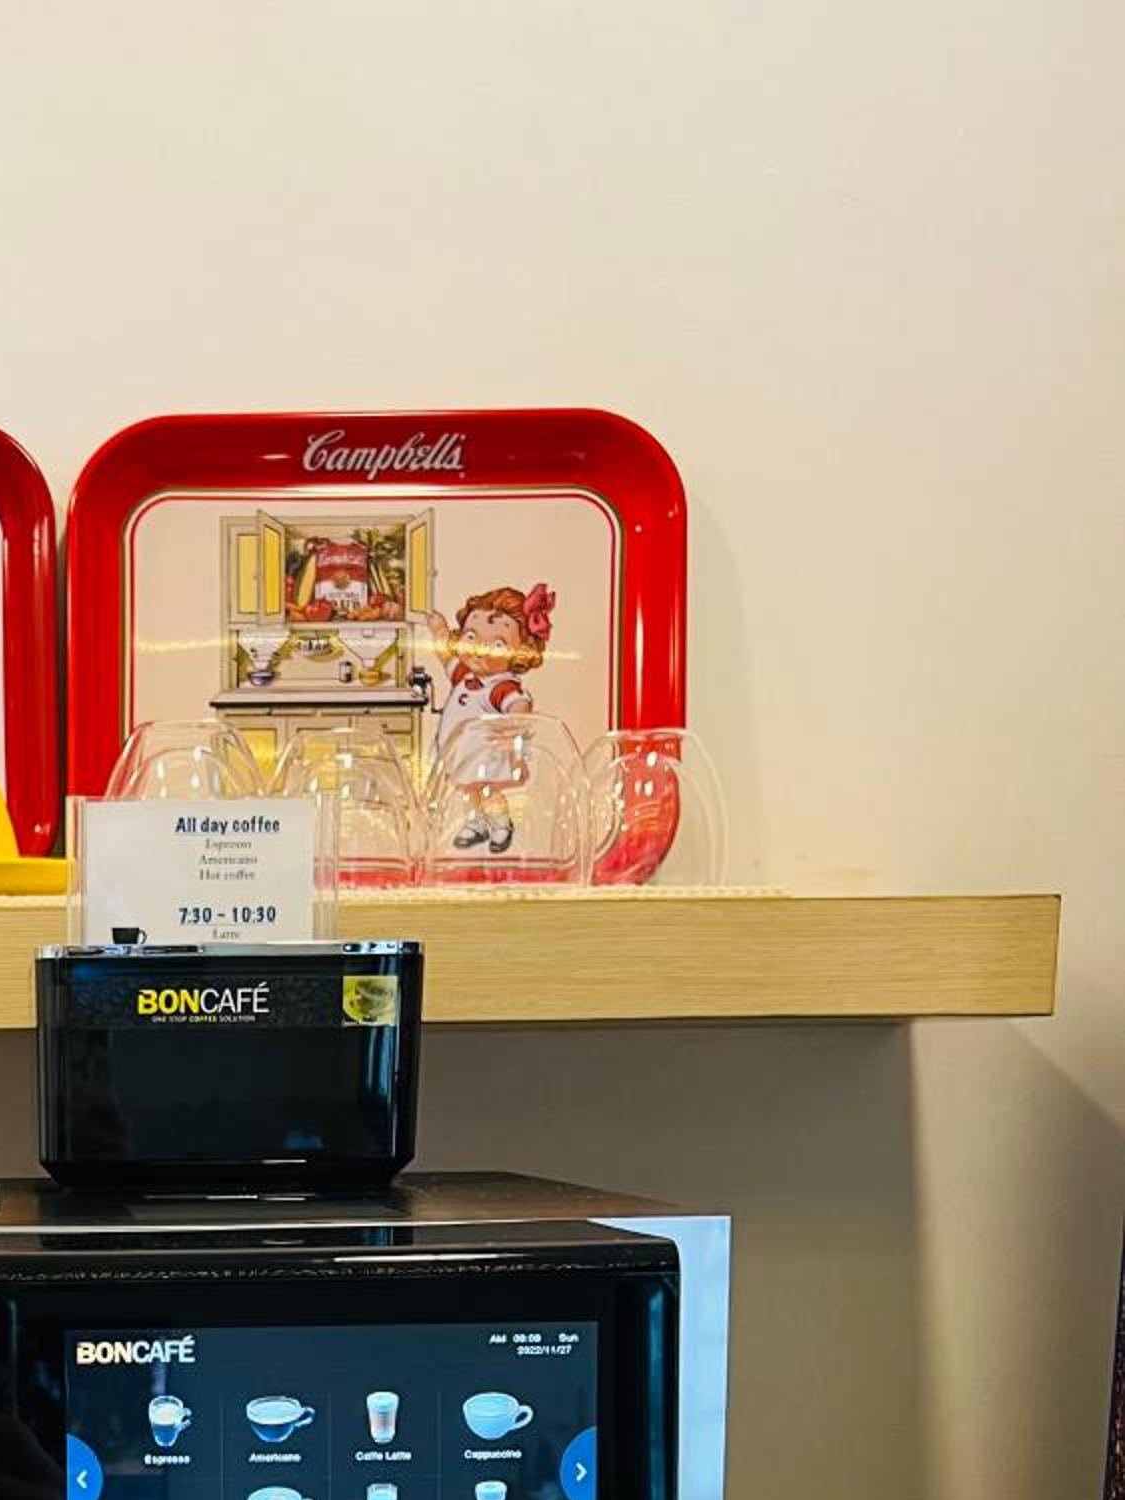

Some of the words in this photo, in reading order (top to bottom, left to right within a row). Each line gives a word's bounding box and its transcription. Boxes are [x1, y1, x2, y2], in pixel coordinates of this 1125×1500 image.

[175, 816, 196, 832] All
[200, 816, 228, 835] day
[233, 815, 281, 833] coffee
[198, 855, 258, 865] Americano
[179, 907, 212, 924] 7:30
[232, 905, 277, 924] 10:30
[138, 981, 271, 1015] BONCAFÉ
[76, 1335, 196, 1364] BONCAFÉ
[144, 1454, 191, 1465] Espresso
[248, 1452, 302, 1463] Americano
[385, 1450, 412, 1461] Latte
[464, 1449, 523, 1461] Cappuccino
